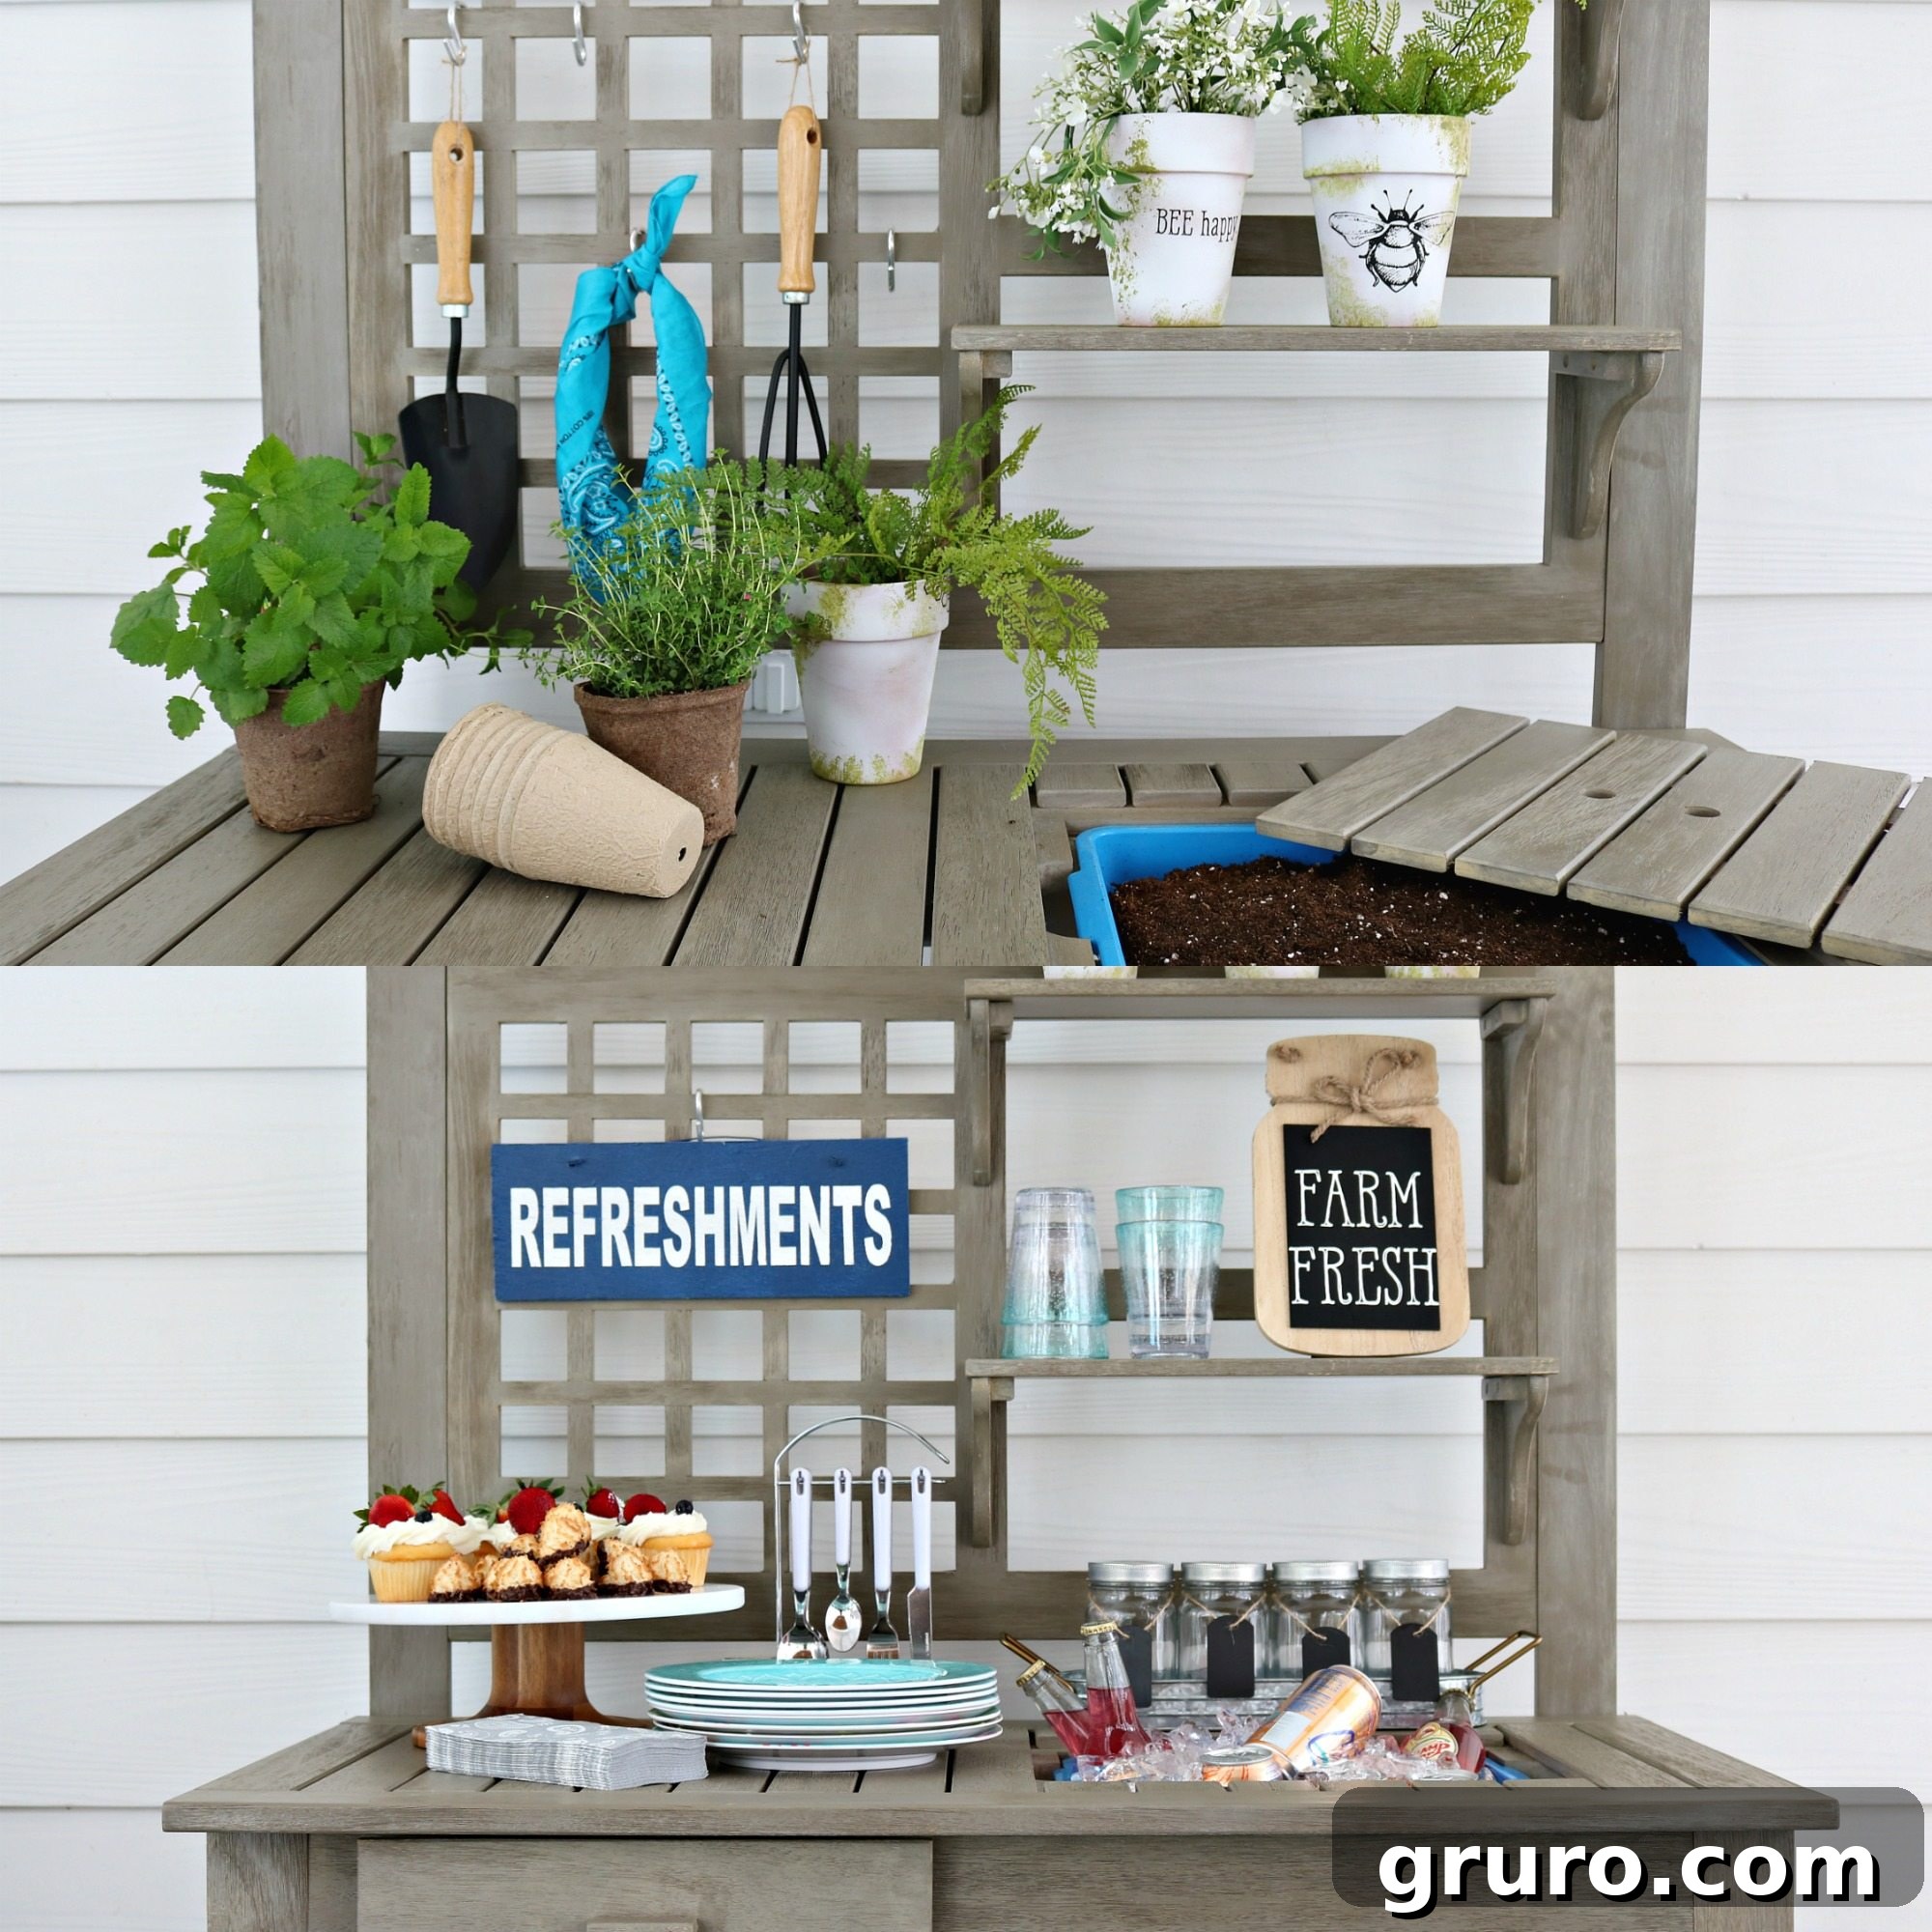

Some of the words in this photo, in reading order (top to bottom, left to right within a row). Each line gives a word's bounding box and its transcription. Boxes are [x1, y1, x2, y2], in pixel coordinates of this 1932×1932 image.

[1155, 208, 1194, 236] BEE
[1200, 210, 1238, 242] happy
[509, 1183, 893, 1267] REFRESHMENTS
[1293, 1169, 1424, 1229] FARM
[1289, 1245, 1440, 1306] FRESH
